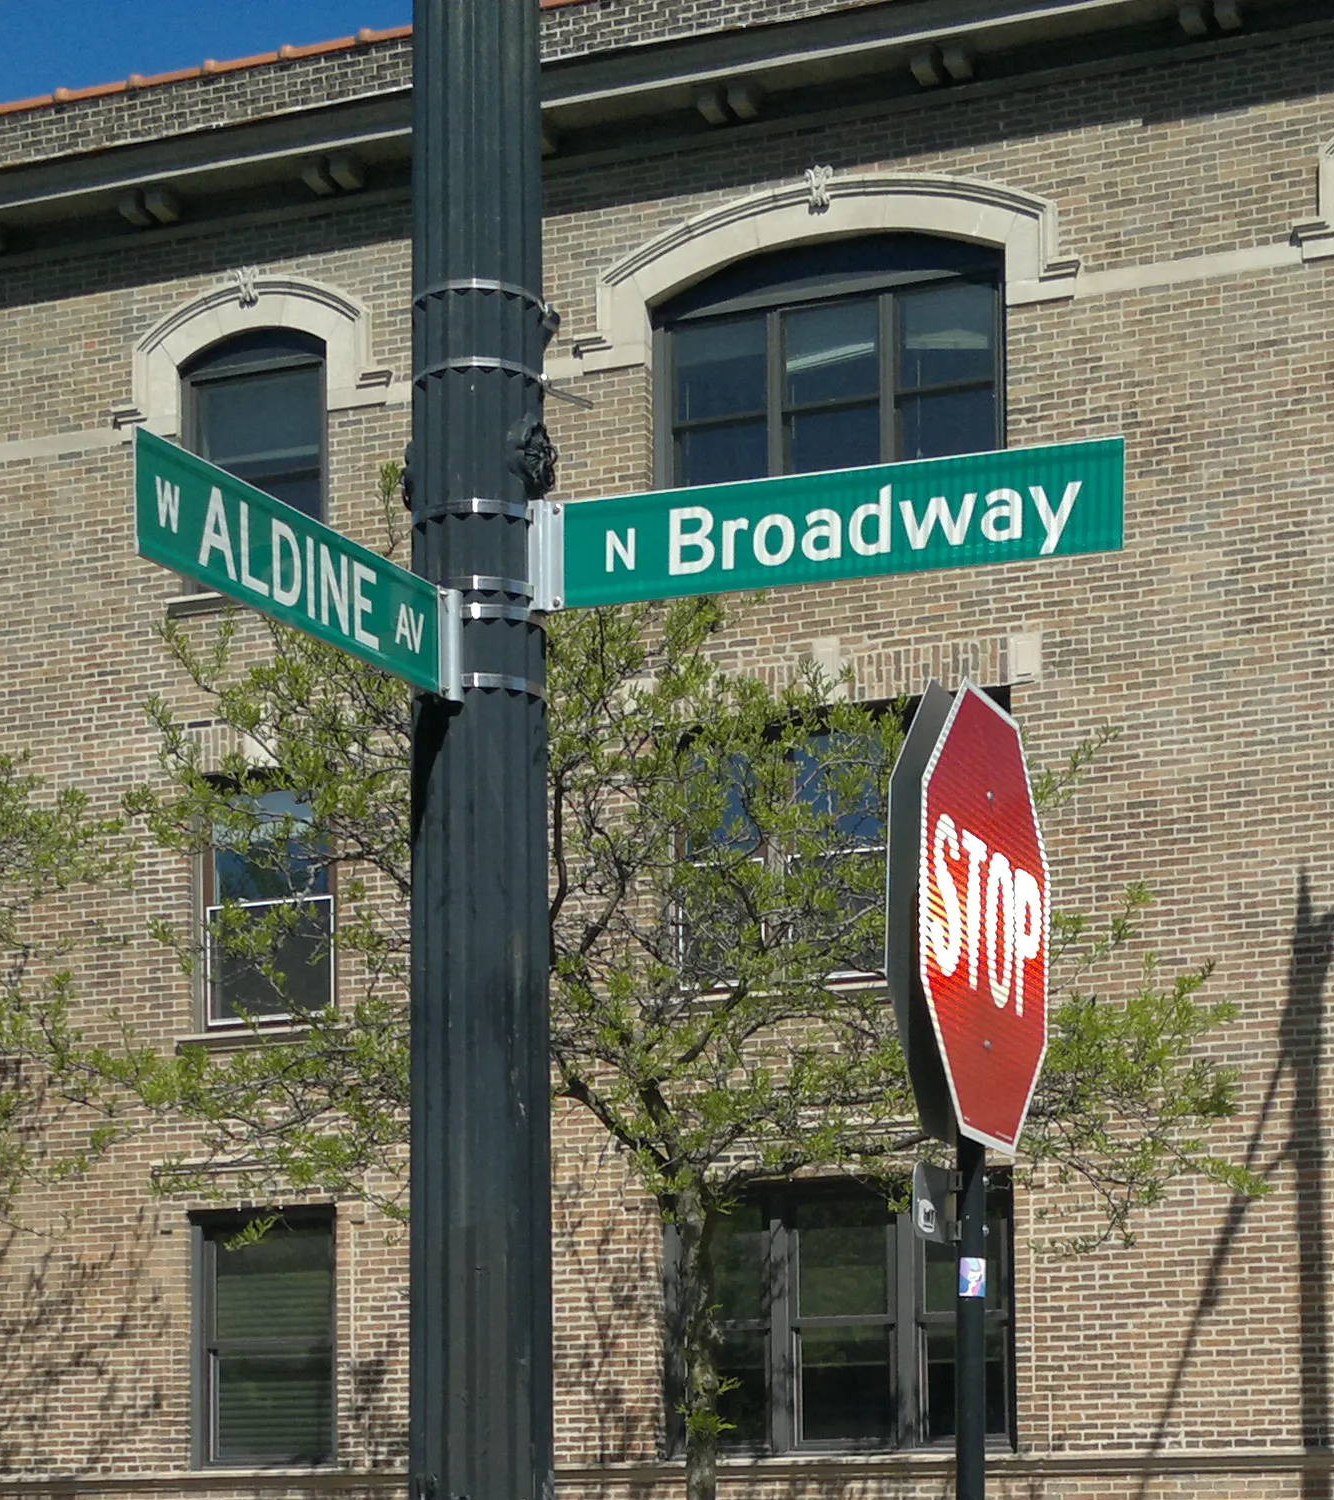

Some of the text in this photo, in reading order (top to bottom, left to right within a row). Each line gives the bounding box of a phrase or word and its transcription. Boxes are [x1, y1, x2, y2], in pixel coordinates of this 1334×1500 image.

[155, 475, 424, 654] W ALDINE AV
[605, 481, 1082, 576] N Broadway
[928, 813, 1041, 1018] STOP
